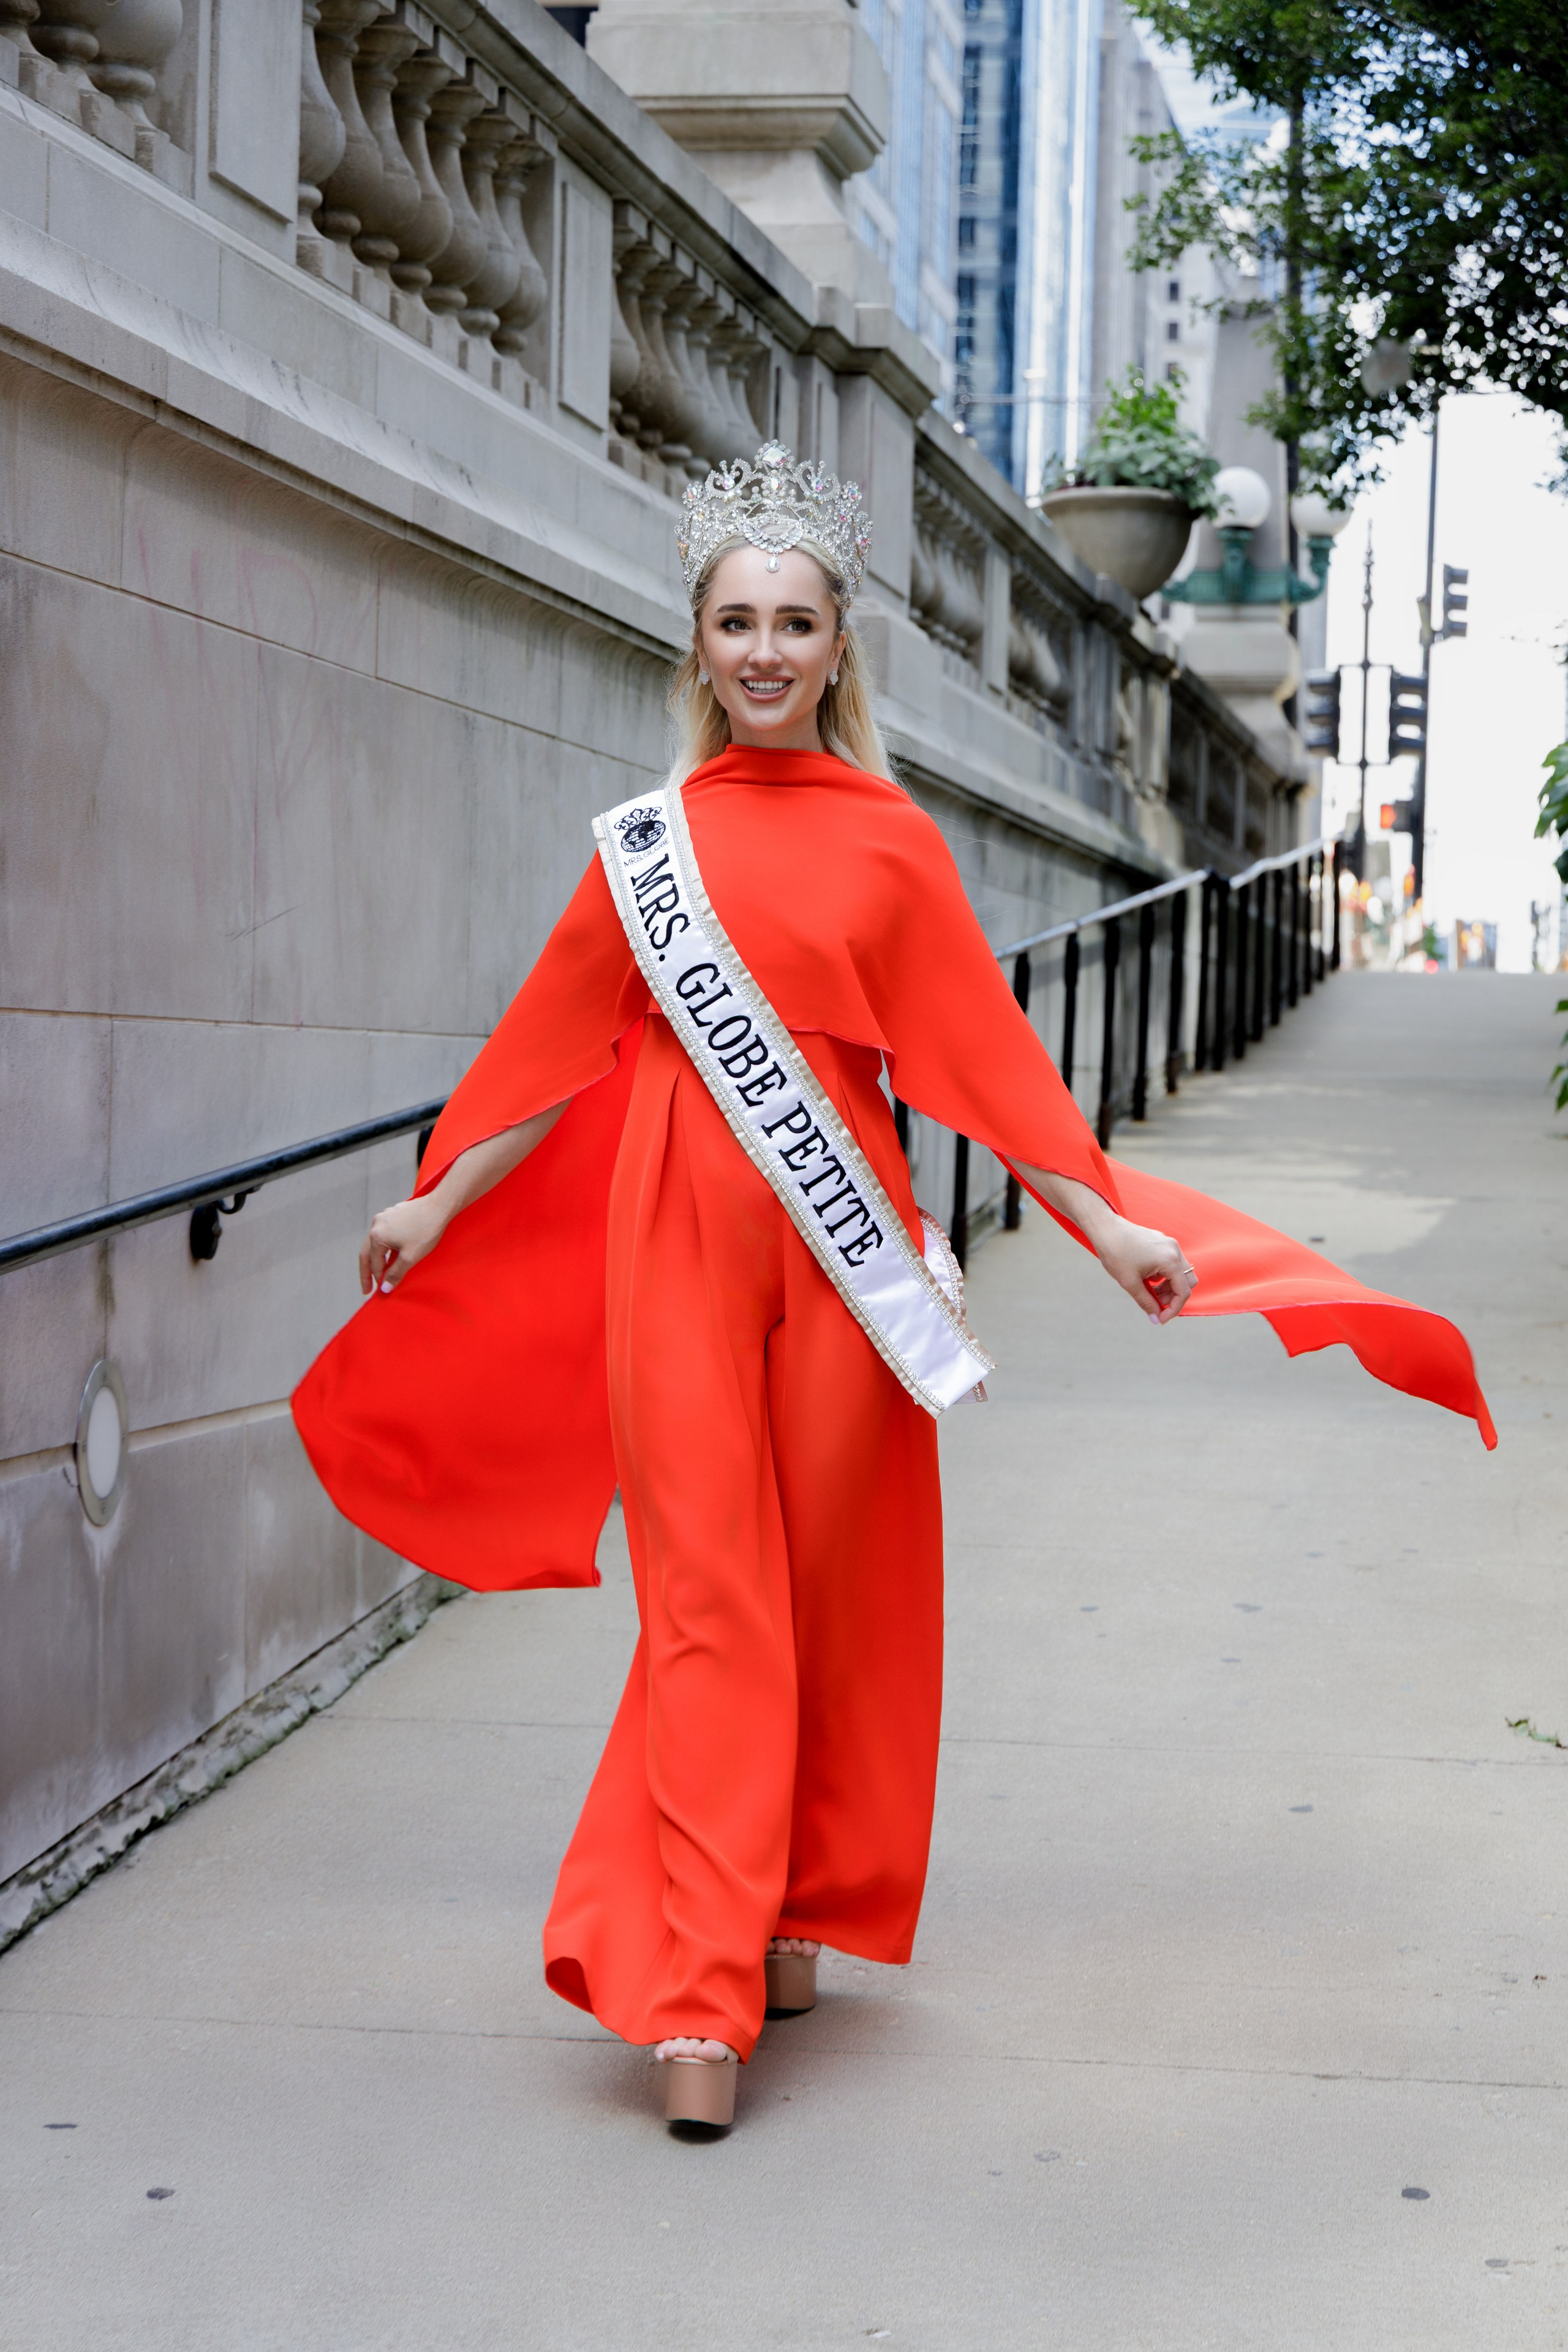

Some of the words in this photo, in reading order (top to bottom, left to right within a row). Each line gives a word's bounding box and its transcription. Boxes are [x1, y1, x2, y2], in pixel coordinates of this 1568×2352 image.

[624, 855, 644, 867] MRS.
[643, 837, 669, 858] GLOBE
[630, 853, 690, 962] MRS.
[676, 962, 788, 1107] GLOBE
[761, 1100, 884, 1268] PETITE
